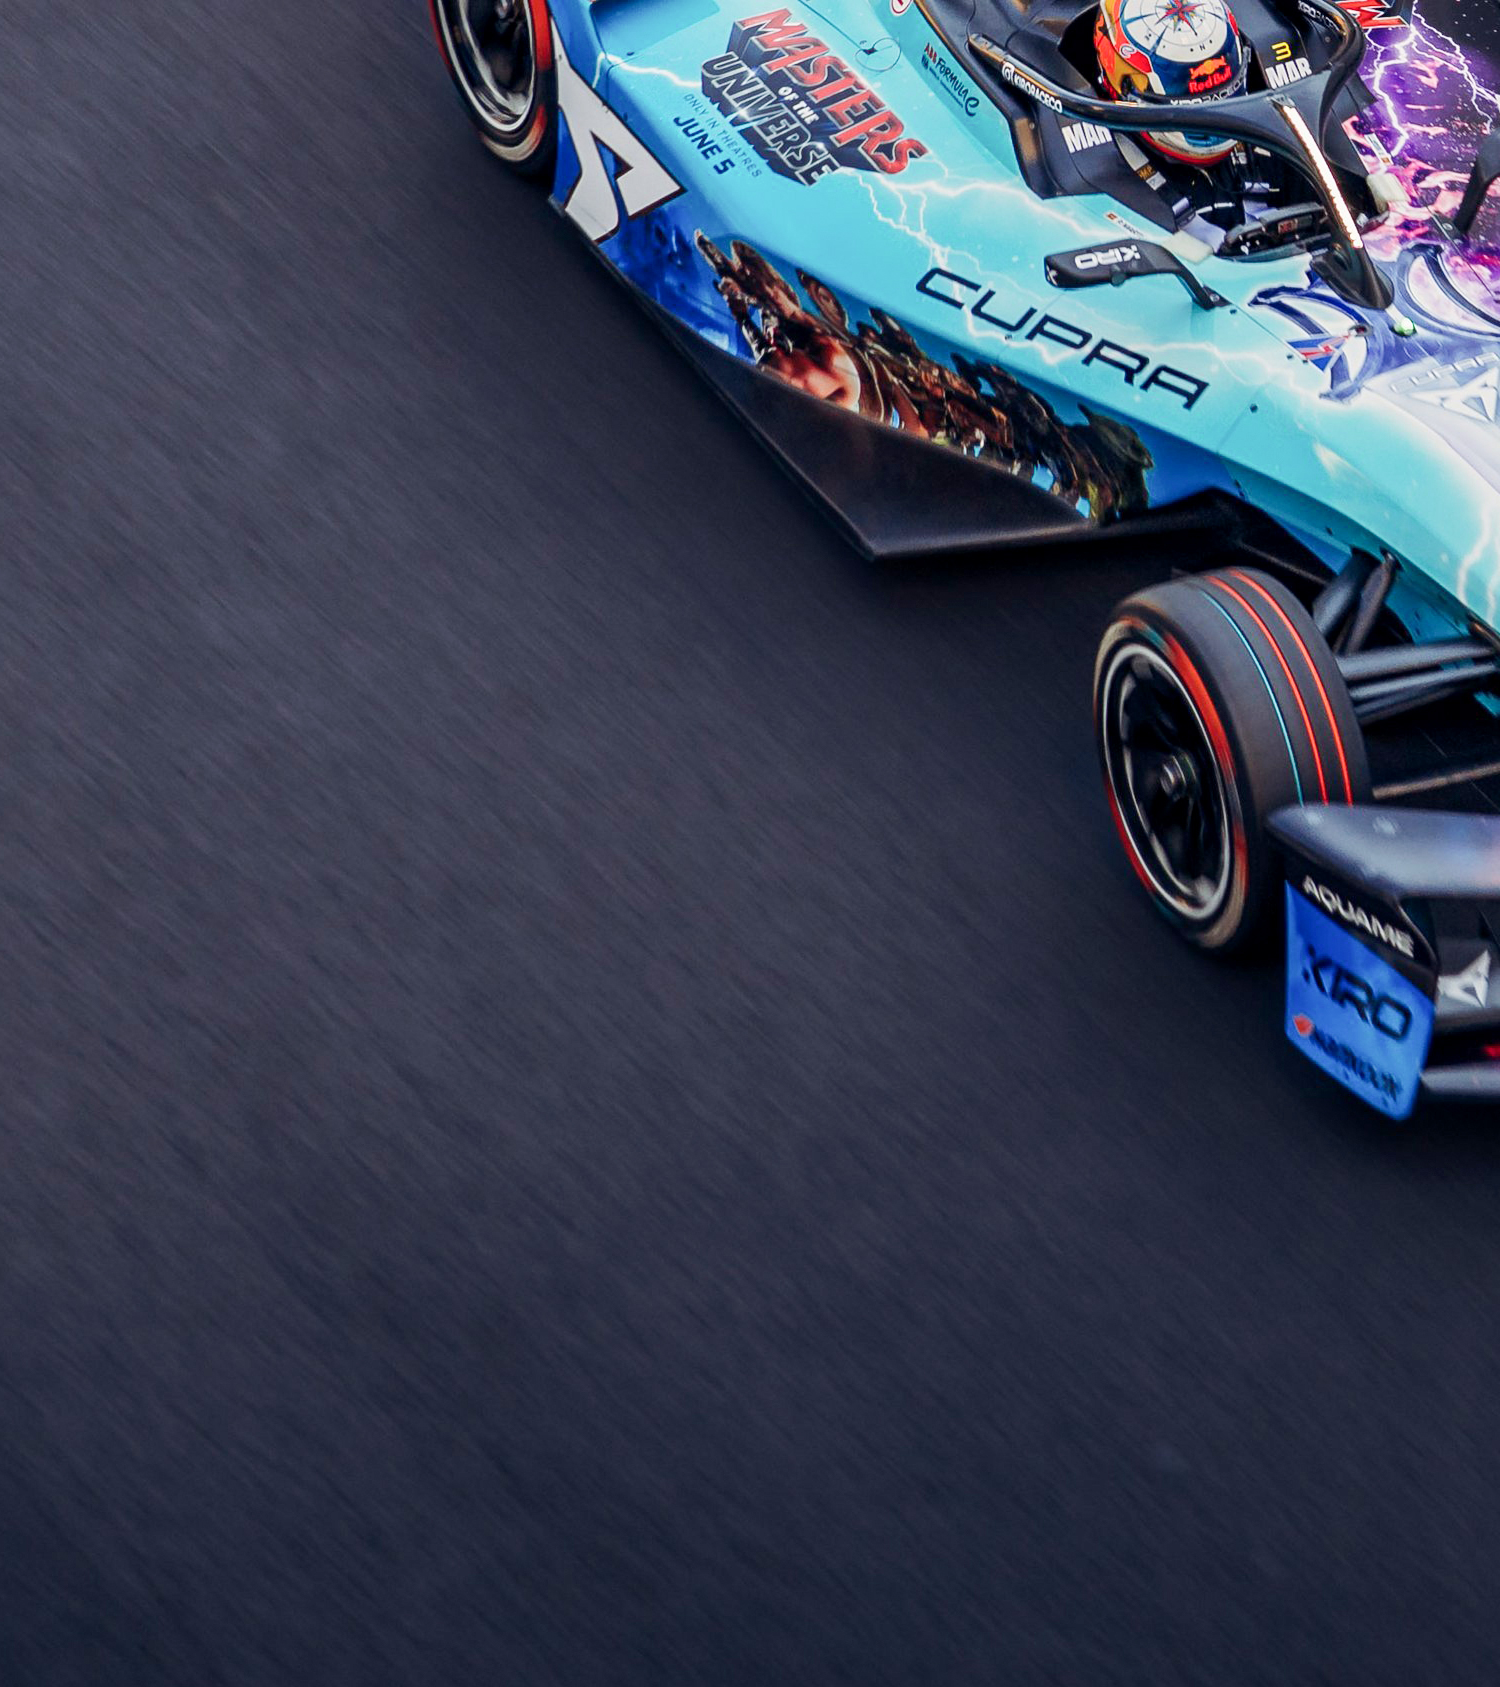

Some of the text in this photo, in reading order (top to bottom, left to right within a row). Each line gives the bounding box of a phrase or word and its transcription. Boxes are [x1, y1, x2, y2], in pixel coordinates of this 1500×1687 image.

[1271, 41, 1292, 61] 3
[684, 93, 707, 120] ONLY
[701, 50, 842, 186] UNIVERSE
[735, 8, 929, 174] MASTERS
[777, 85, 820, 124] OF THE
[673, 115, 736, 176] JUNE 5
[915, 266, 1210, 411] CUPRA
